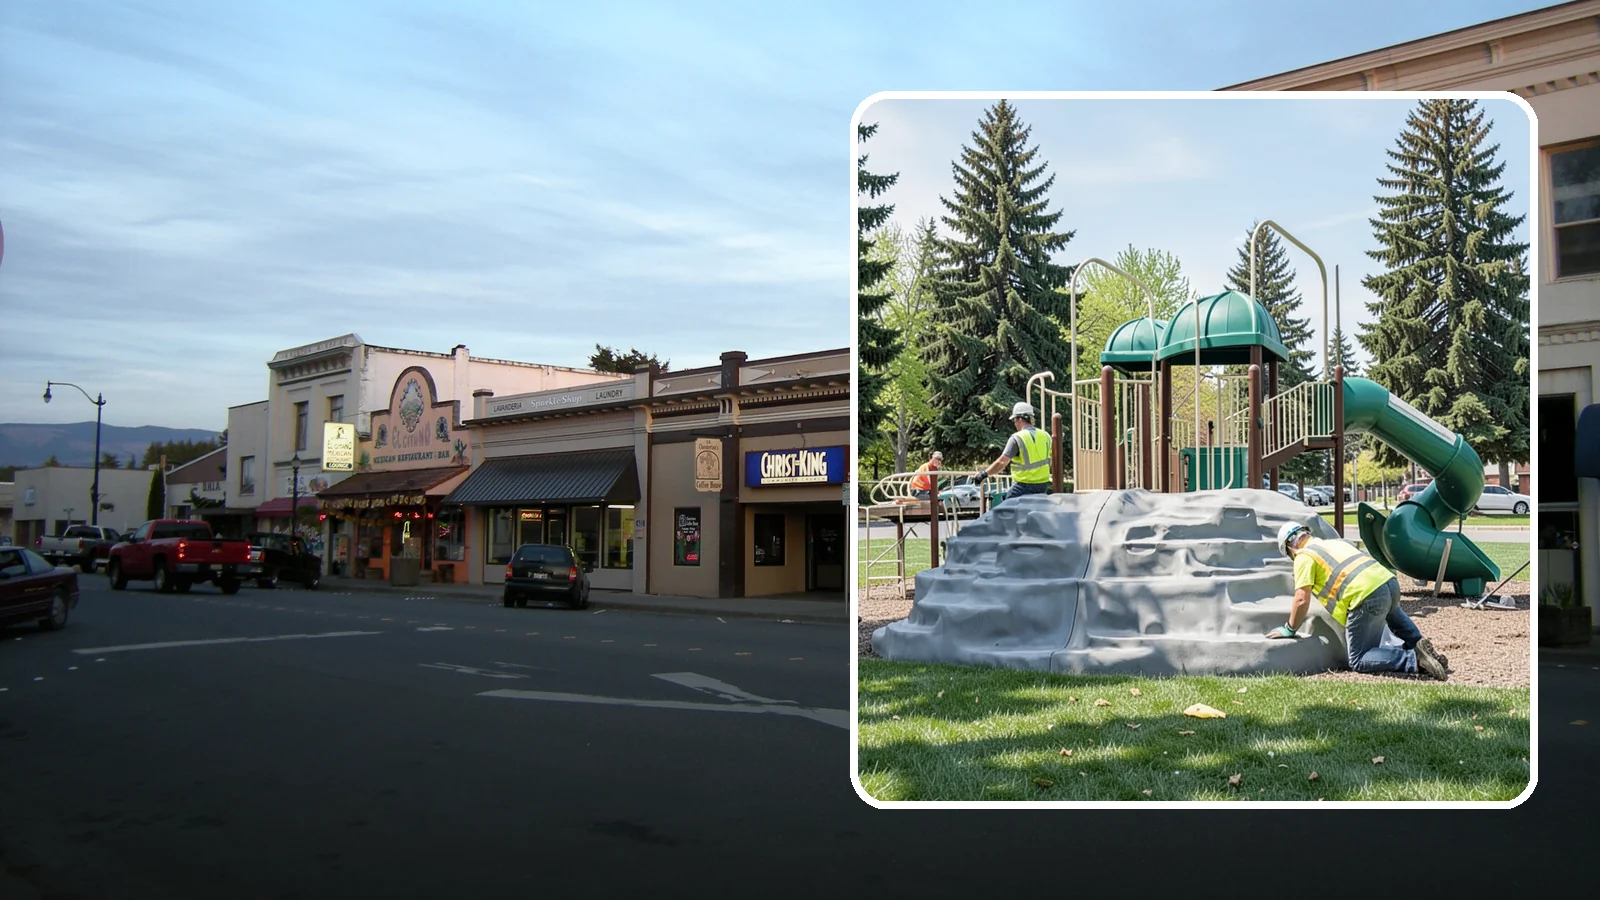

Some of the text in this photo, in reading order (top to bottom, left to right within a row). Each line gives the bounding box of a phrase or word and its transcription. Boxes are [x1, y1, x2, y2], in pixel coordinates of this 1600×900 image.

[531, 394, 582, 408] Sparkle Shop
[595, 389, 623, 400] LAUNDRY
[493, 402, 522, 412] LAVANDERIA
[373, 455, 396, 464] MEXICAN
[397, 451, 433, 462] RESTAURANT
[438, 449, 450, 459] BAR
[760, 449, 827, 478] CHRIST KING
